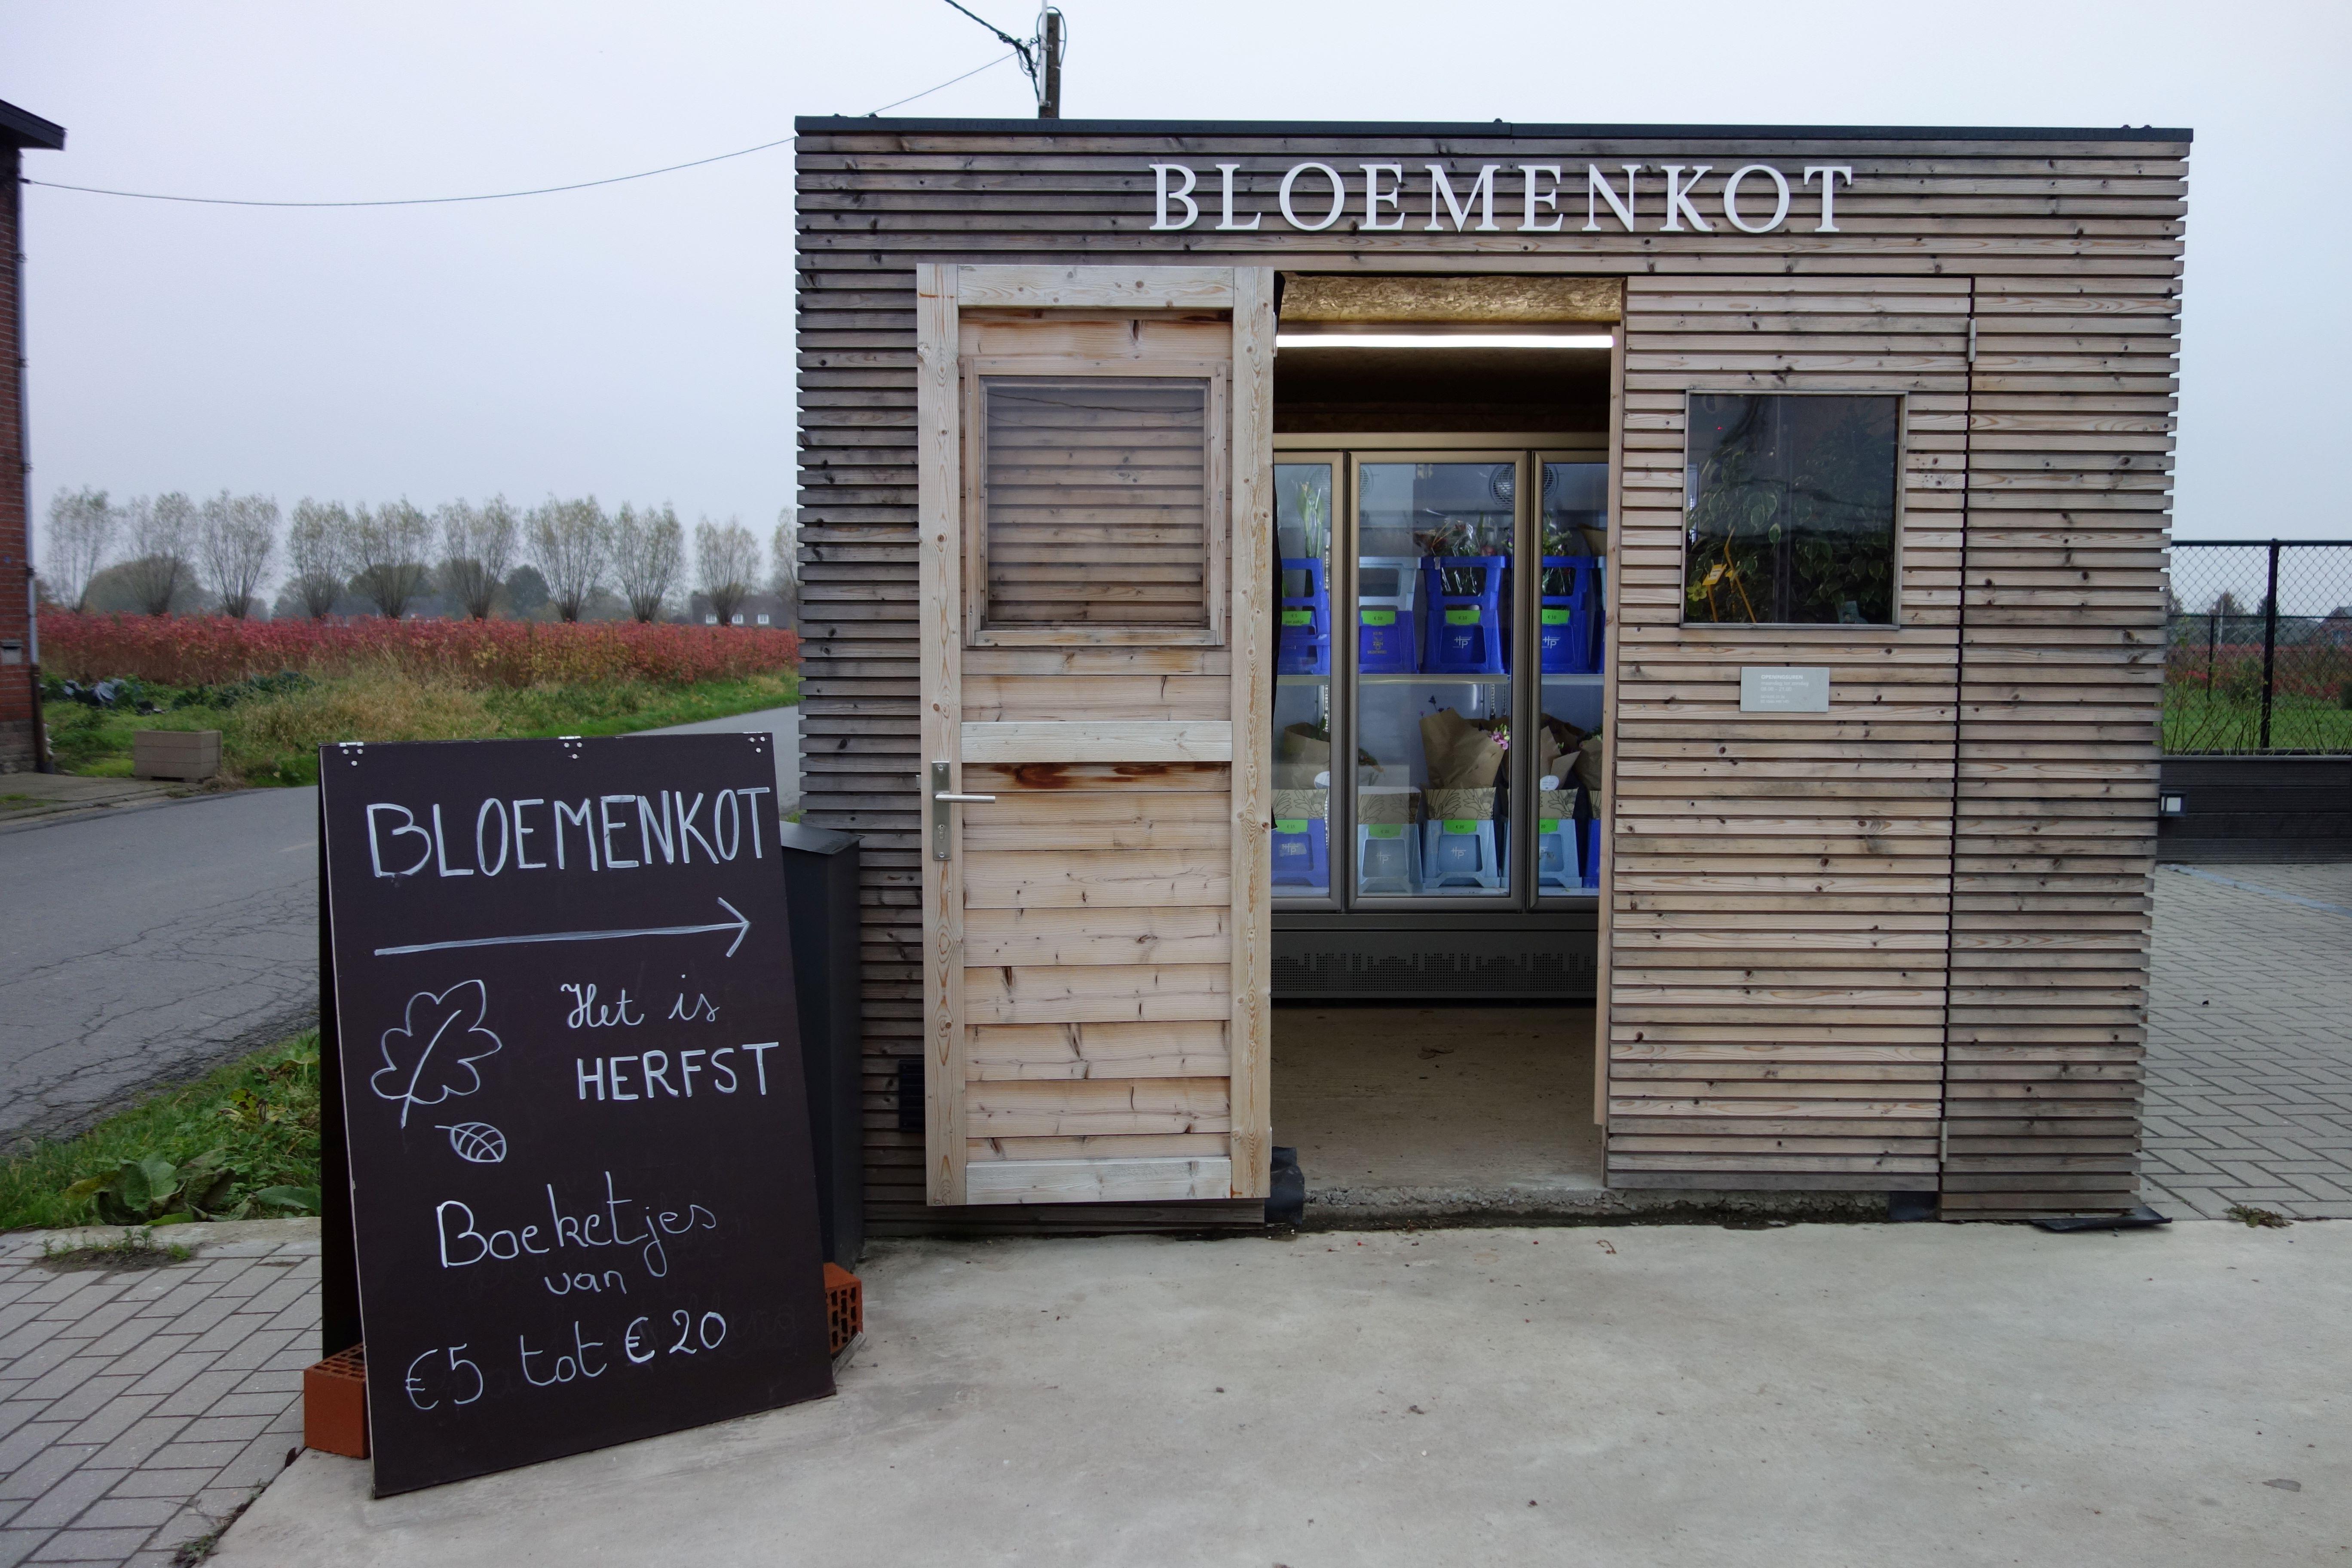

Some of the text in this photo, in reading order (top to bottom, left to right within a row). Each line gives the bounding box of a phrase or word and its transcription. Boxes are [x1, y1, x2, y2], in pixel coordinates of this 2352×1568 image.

[1149, 162, 1851, 232] BLOEMENKOT
[367, 787, 770, 878] BLOEMENKOT
[560, 975, 720, 1028] Het is
[577, 1041, 779, 1100] HERFST
[436, 1171, 716, 1278] Boeketjes
[545, 1270, 627, 1294] van
[521, 1321, 607, 1386] tot
